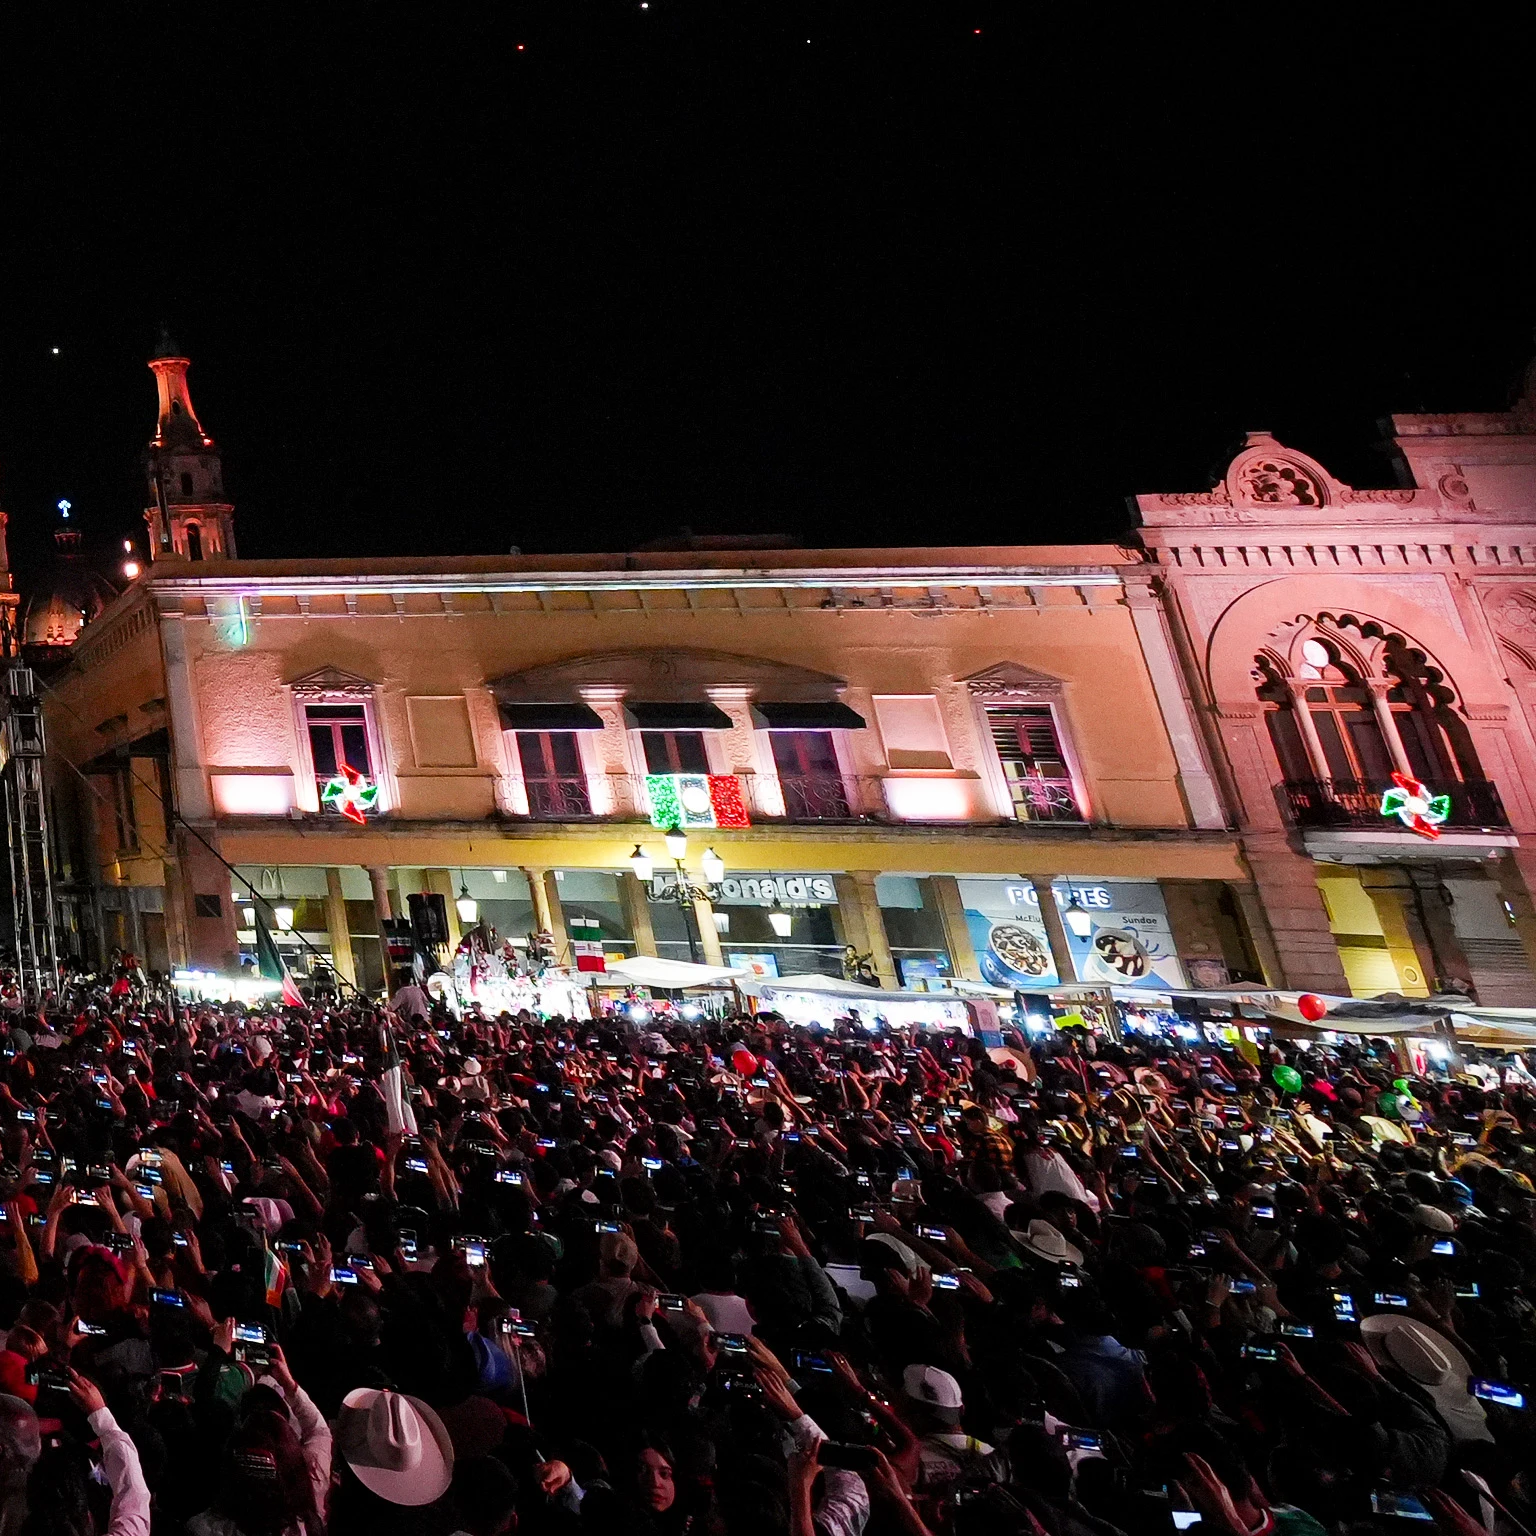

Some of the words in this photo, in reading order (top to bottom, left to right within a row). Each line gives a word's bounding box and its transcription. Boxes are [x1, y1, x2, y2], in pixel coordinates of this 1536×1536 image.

[652, 874, 833, 900] Monald's
[1007, 886, 1113, 909] POTRES
[1122, 916, 1157, 924] Sundae
